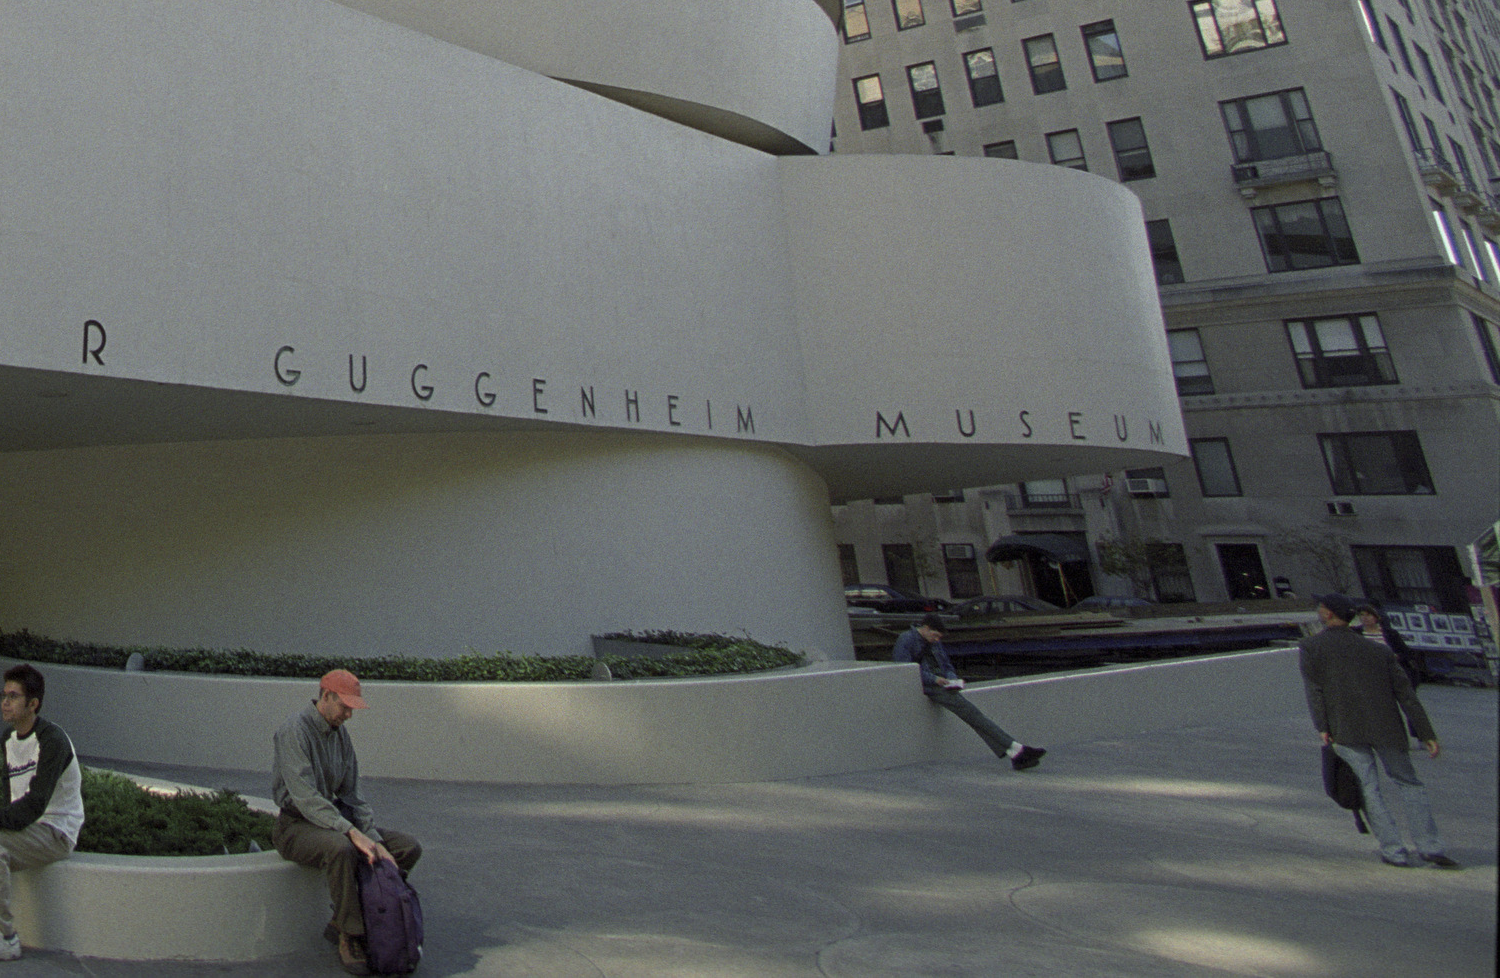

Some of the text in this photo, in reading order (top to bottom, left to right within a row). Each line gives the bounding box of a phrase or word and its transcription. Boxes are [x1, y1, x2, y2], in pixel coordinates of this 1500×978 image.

[82, 319, 107, 366] R
[273, 345, 756, 435] GUGGENHEIM
[876, 410, 1165, 445] MUSEUM
